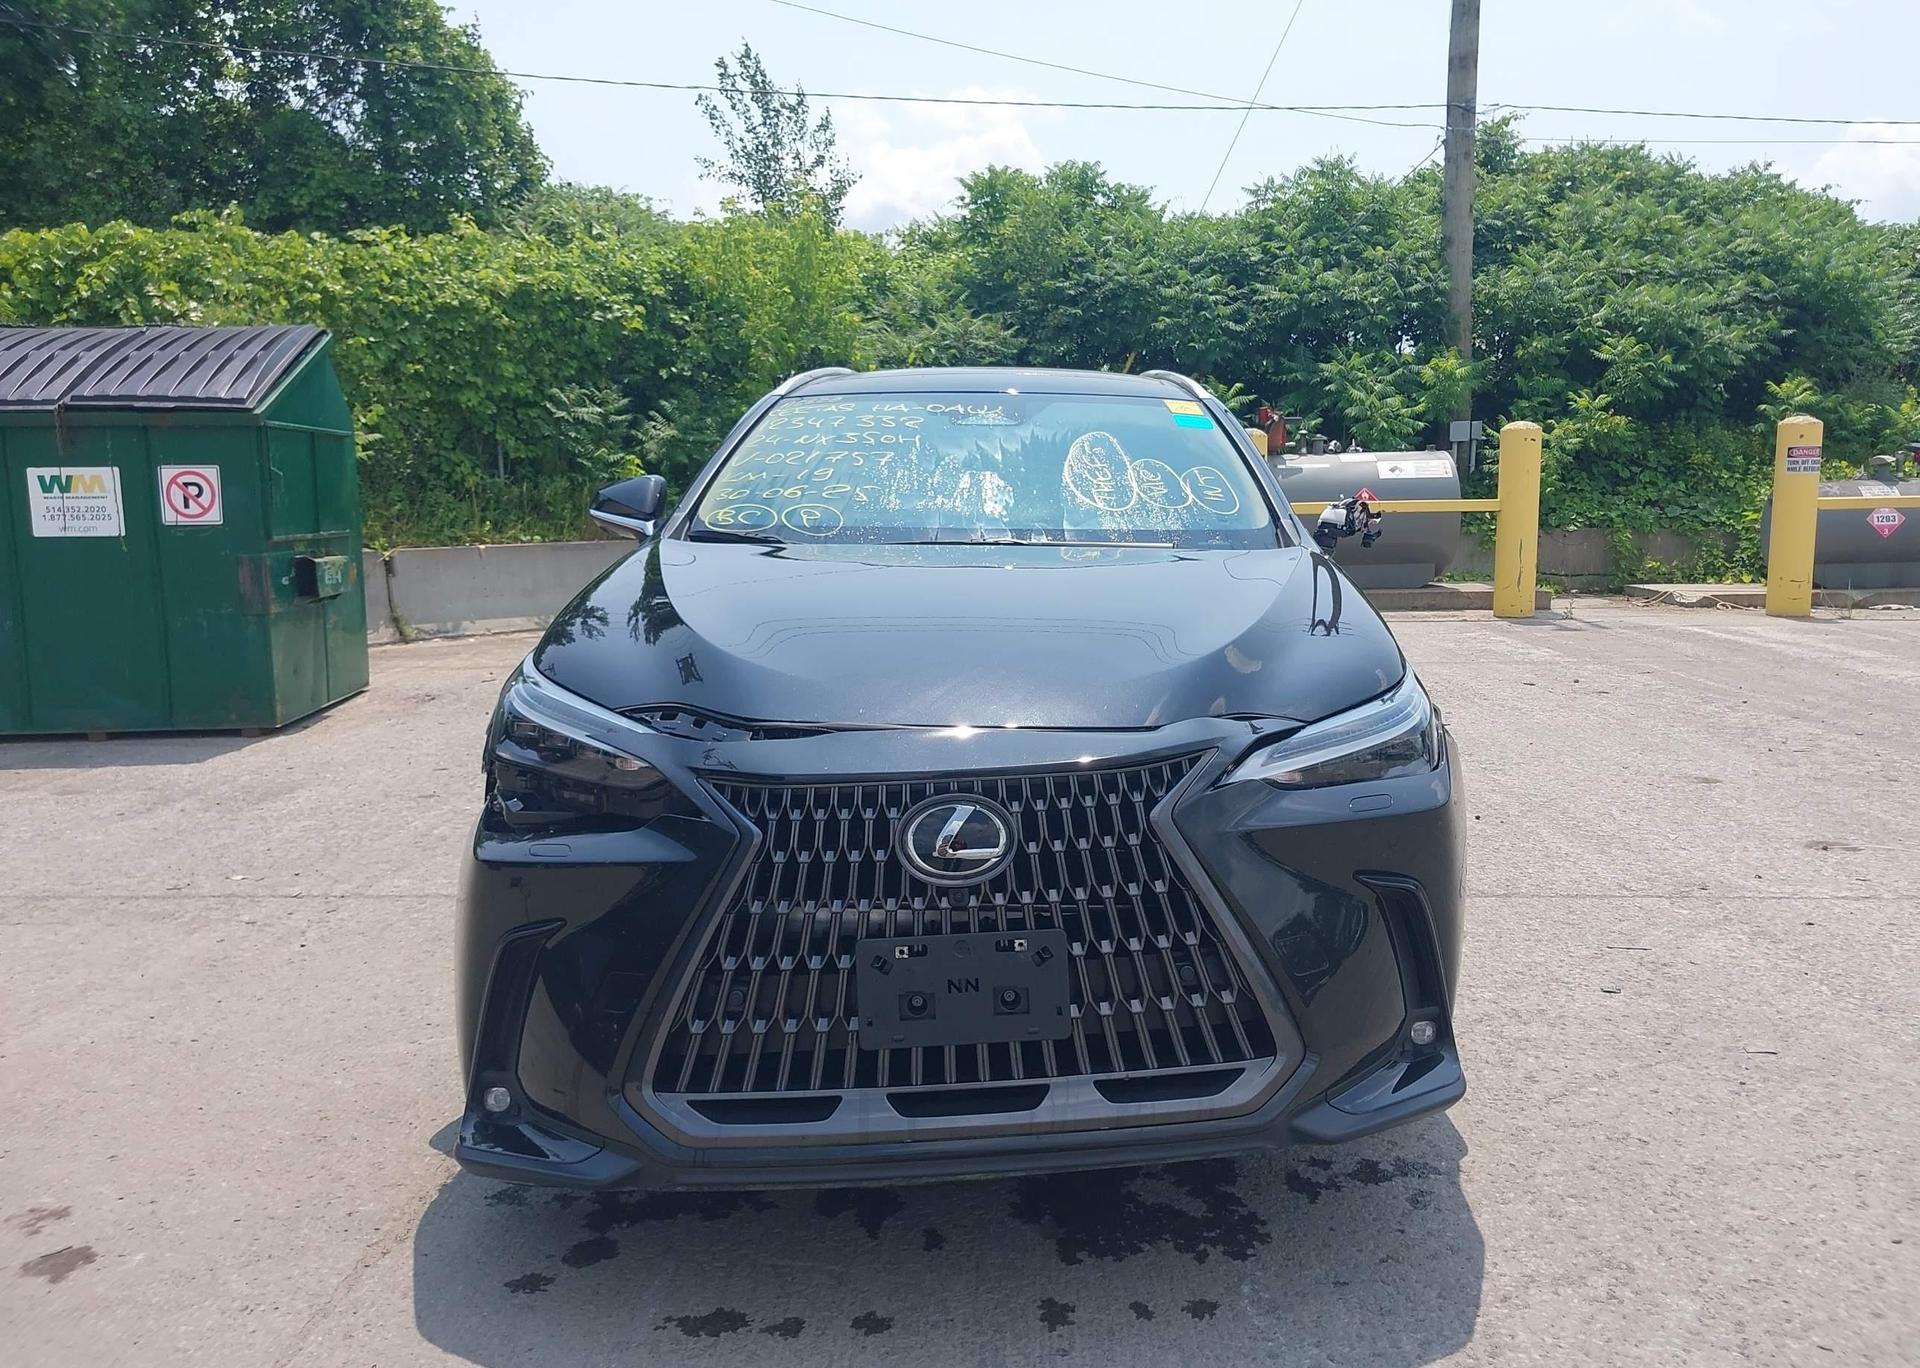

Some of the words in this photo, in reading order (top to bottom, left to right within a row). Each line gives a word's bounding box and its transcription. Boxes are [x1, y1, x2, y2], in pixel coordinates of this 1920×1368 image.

[37, 475, 107, 494] WM
[42, 513, 113, 522] 1.877.565.2025
[1876, 515, 1897, 523] 1203
